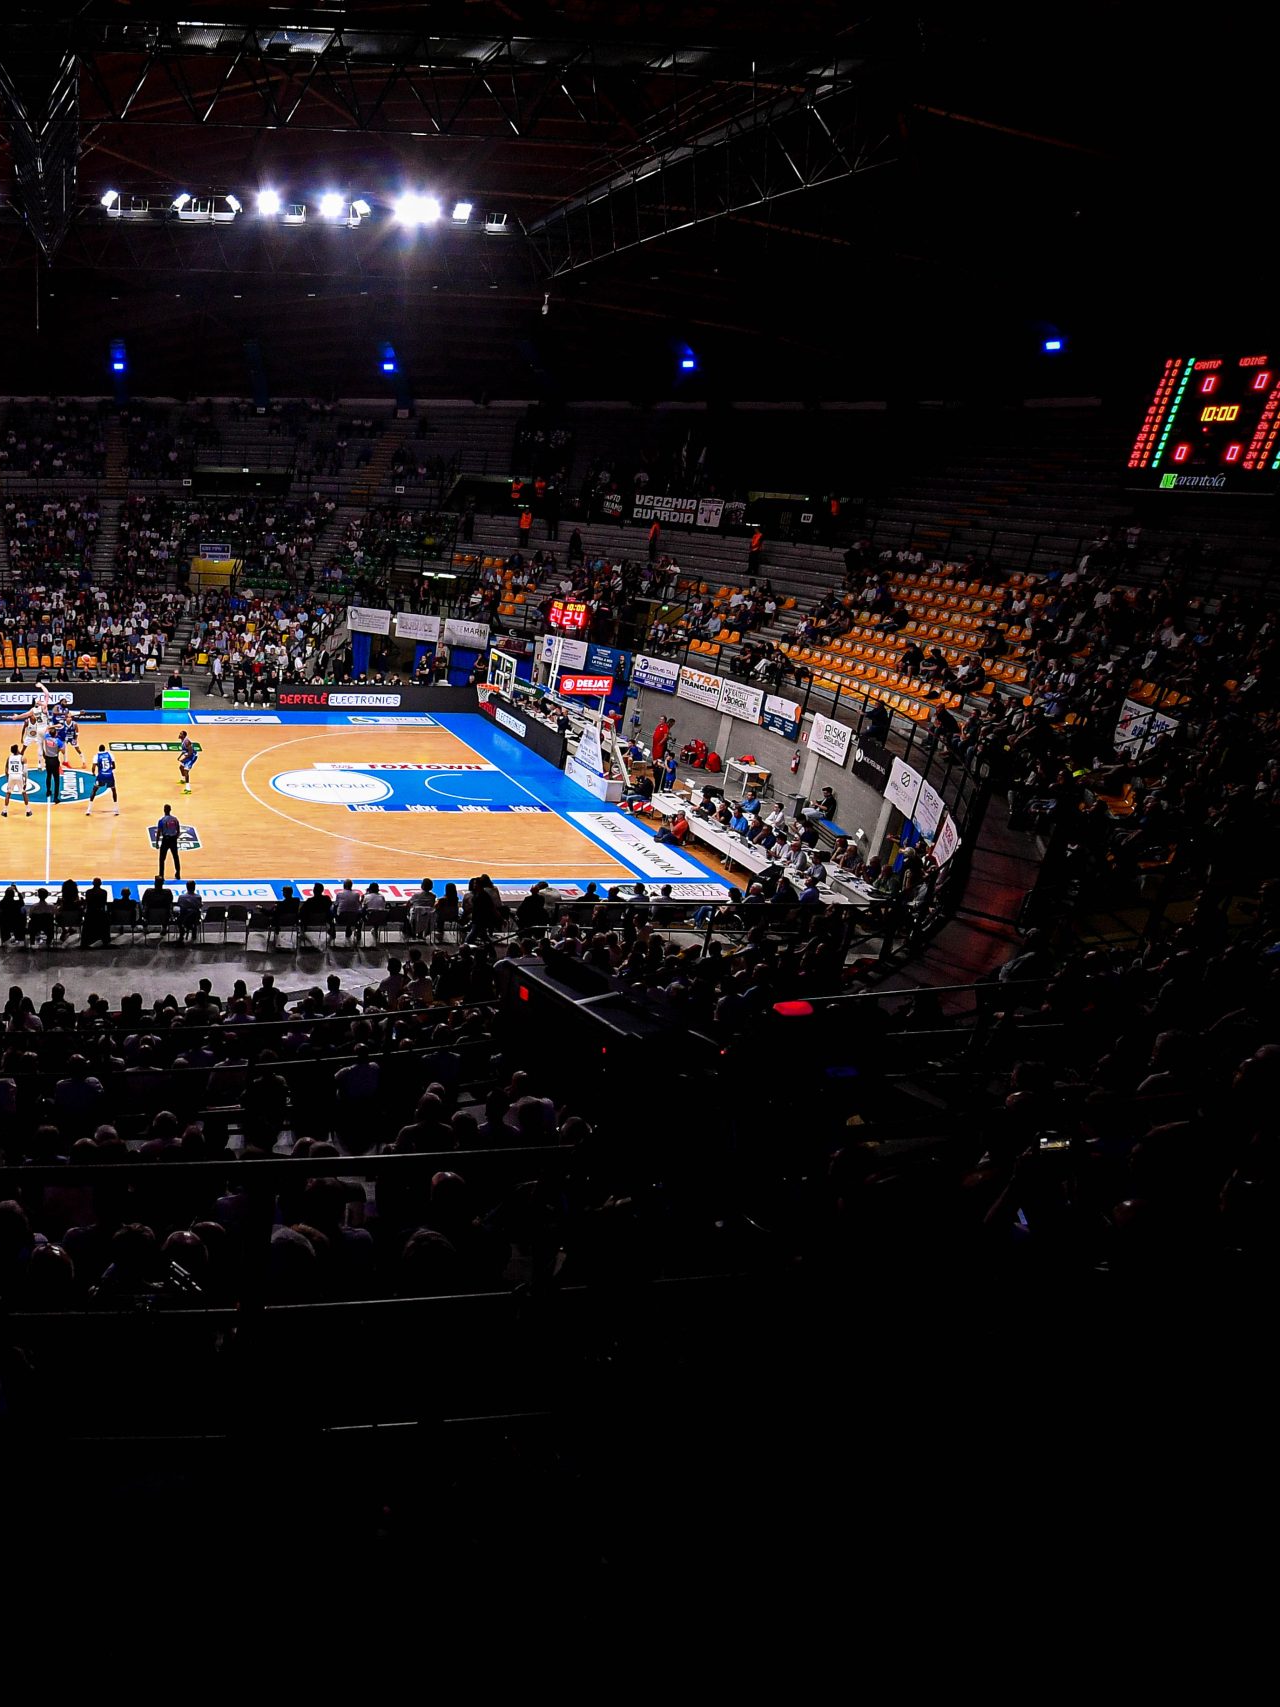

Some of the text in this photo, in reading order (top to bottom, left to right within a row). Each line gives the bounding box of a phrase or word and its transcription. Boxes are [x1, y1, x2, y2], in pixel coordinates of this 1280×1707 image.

[1239, 356, 1268, 367] UDINE
[1202, 377, 1216, 392] 0
[1254, 373, 1269, 389] 0
[1201, 406, 1239, 421] 10:00
[1175, 446, 1188, 460] 0
[1226, 445, 1240, 460] 0
[634, 494, 697, 510] VECCHIA
[633, 508, 695, 524] GUARDIA
[562, 611, 584, 625] 24
[576, 679, 610, 688] DEEJAY
[681, 669, 720, 688] EXTRA
[681, 678, 719, 695] TRANCIATI
[329, 695, 400, 706] ELECTRONICS
[10, 764, 19, 773] 45
